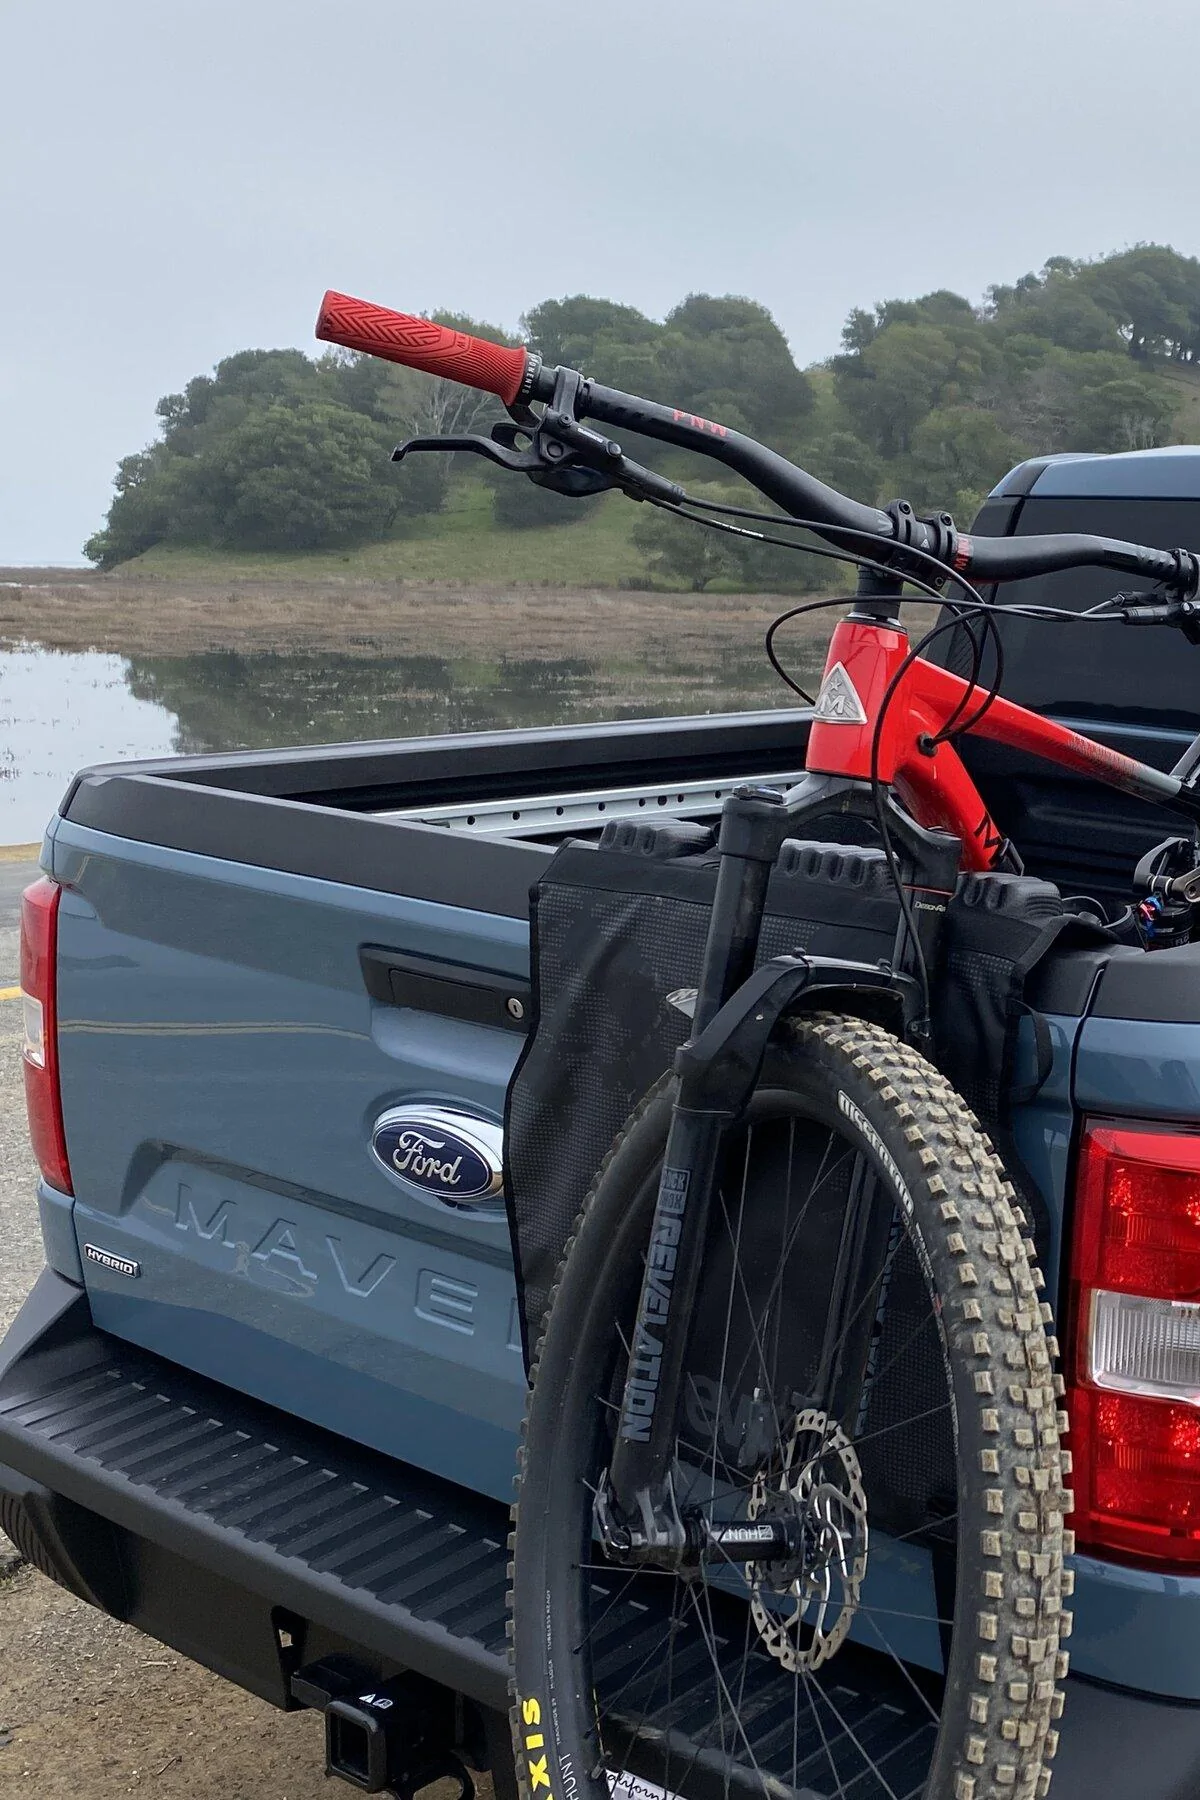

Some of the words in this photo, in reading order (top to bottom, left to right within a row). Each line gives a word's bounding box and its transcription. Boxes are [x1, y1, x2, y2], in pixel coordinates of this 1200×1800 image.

[672, 410, 727, 437] PNW
[393, 1131, 462, 1185] Ford
[87, 1248, 133, 1274] HYBRID
[620, 1214, 682, 1442] REVELATION
[523, 1698, 553, 1800] XIS
[559, 1754, 579, 1800] HUNT
